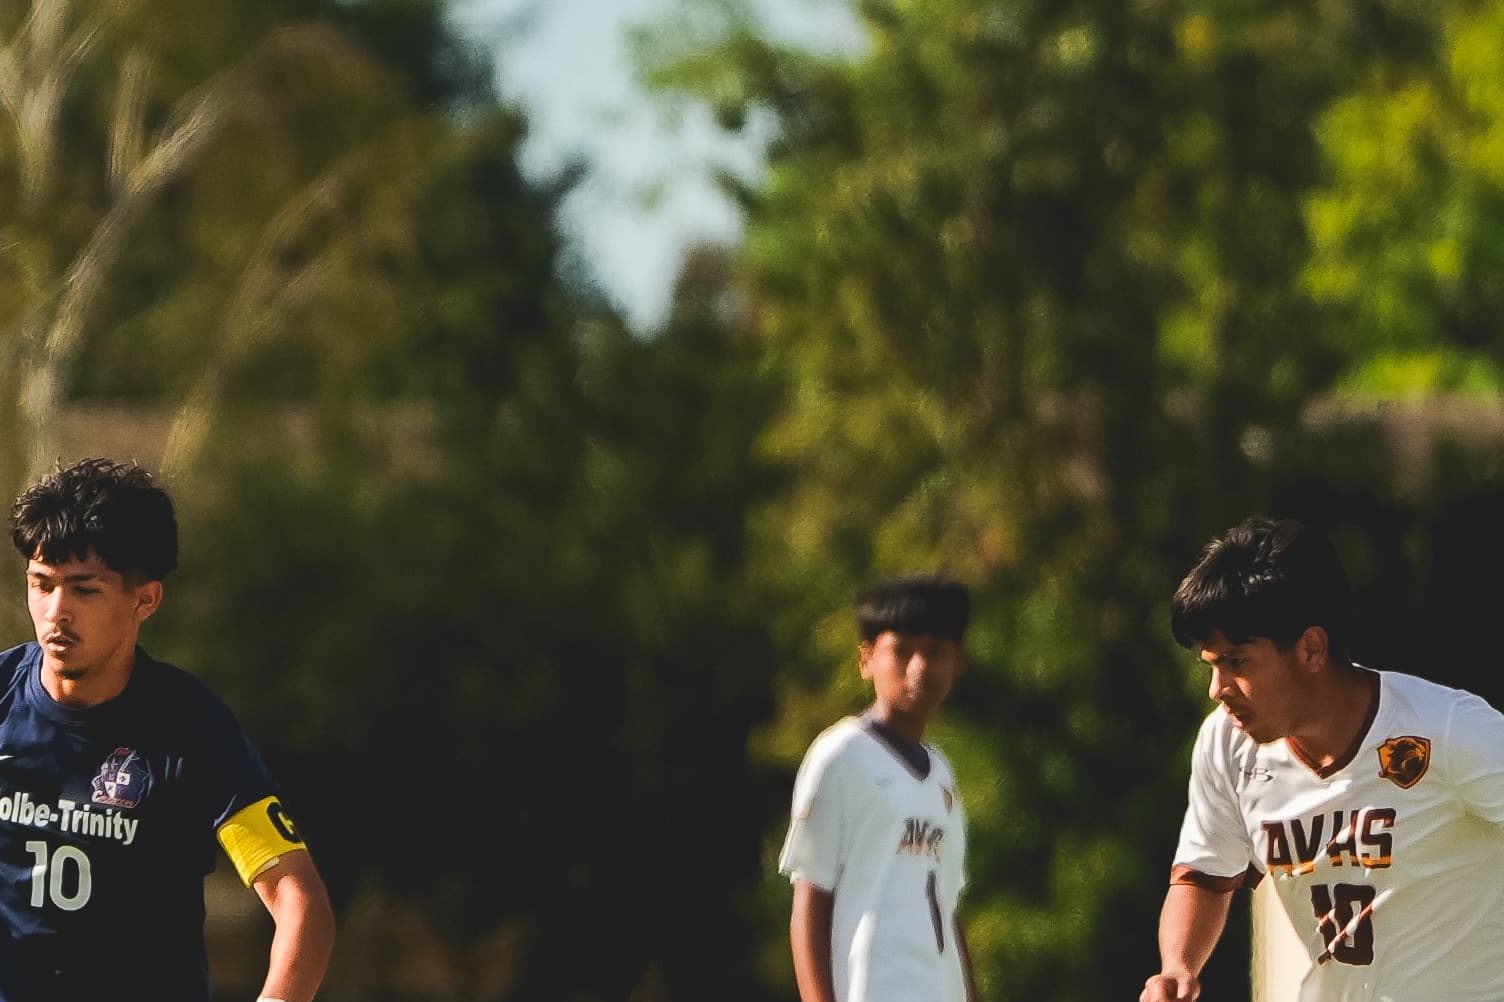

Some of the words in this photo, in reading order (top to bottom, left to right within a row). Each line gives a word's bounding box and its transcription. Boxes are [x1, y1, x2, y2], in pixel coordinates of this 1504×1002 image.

[24, 841, 93, 911] 10
[1261, 807, 1397, 877] AVHS
[1310, 882, 1377, 966] 10
